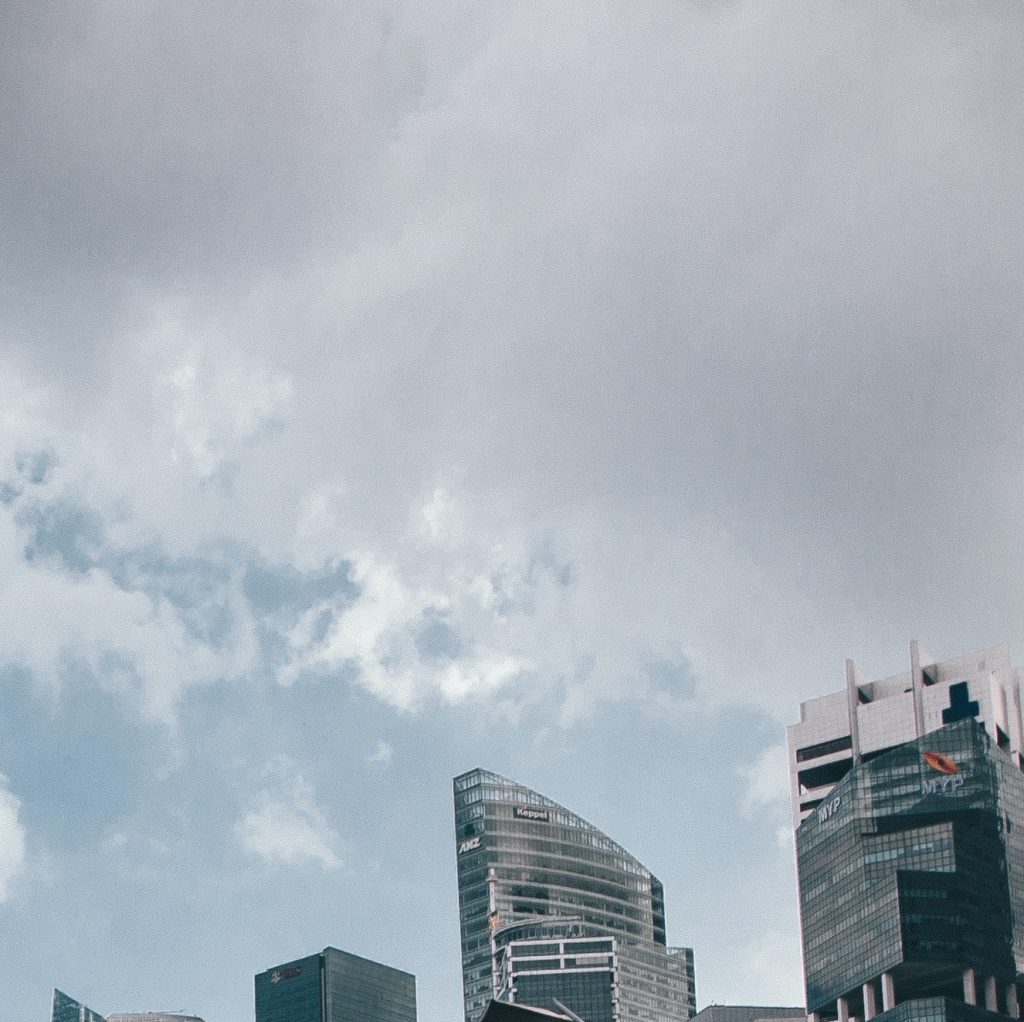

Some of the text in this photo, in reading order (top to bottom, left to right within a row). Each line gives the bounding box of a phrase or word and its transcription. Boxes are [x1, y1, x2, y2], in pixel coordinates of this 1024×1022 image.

[921, 777, 963, 795] MYP
[516, 807, 548, 819] Keppel
[818, 796, 841, 824] MYP
[459, 837, 480, 854] ANZ
